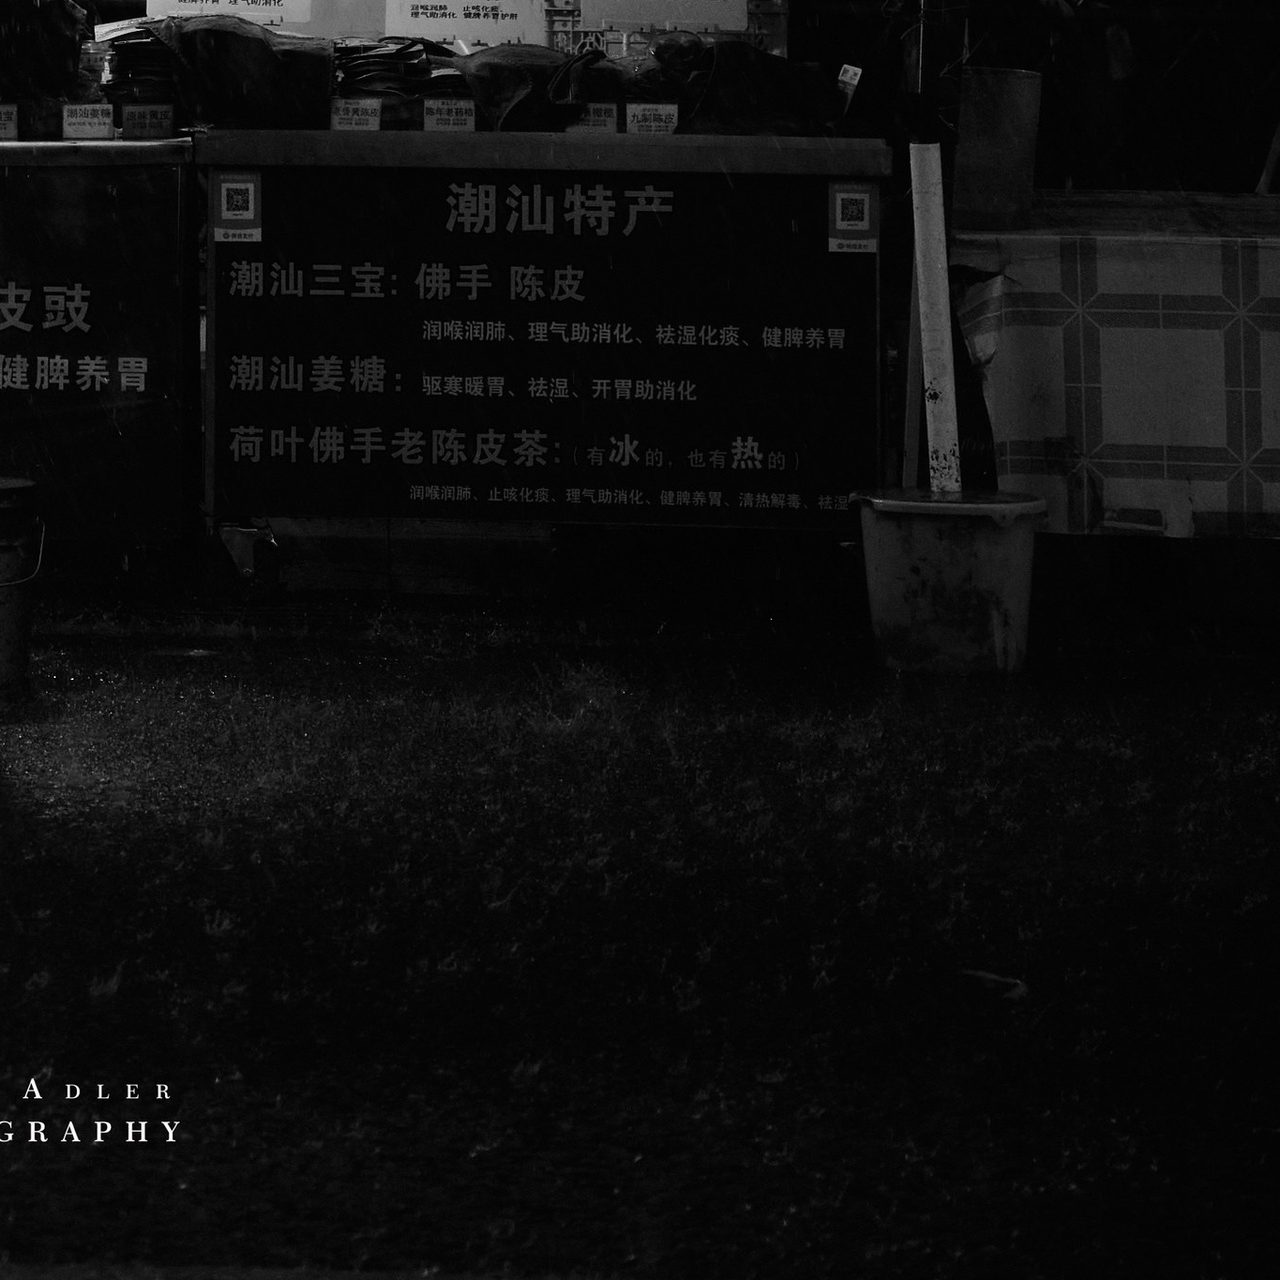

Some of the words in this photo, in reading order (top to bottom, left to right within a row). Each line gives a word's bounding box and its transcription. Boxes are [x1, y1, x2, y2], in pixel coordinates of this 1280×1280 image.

[444, 181, 675, 238] 潮汕特产
[509, 264, 587, 303] 陈皮
